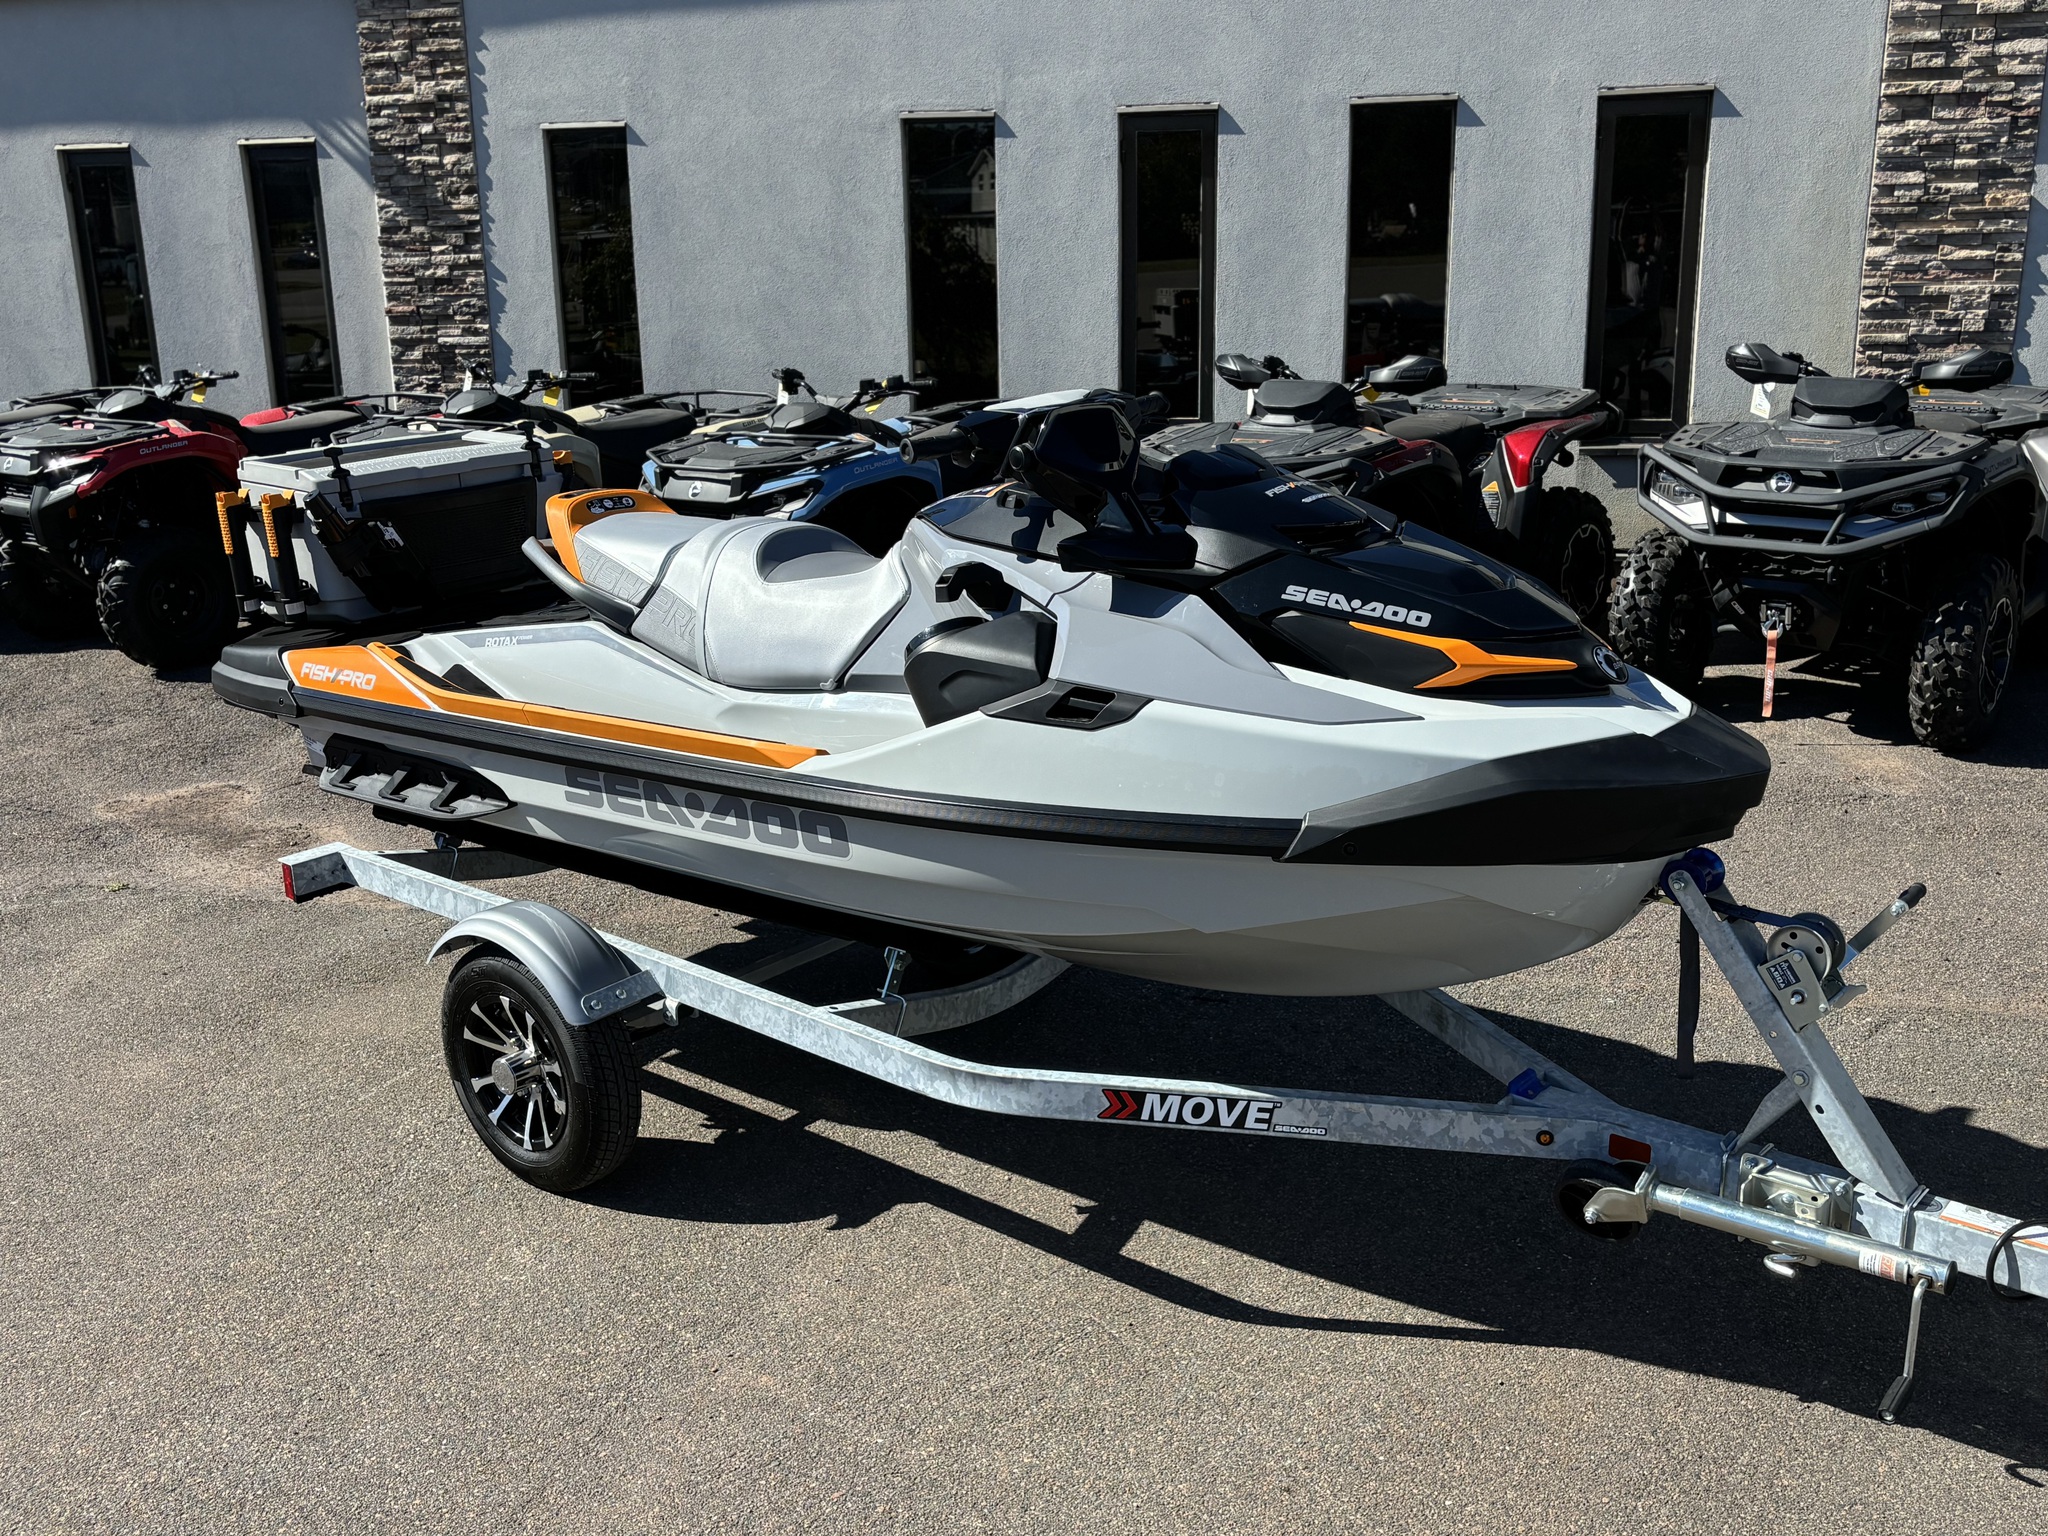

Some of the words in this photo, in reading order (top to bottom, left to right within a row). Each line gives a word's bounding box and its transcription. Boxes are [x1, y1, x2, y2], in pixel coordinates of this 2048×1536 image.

[139, 440, 189, 455] OUTLANDER
[853, 457, 899, 475] OUTLANDER
[484, 635, 518, 648] ROTAX
